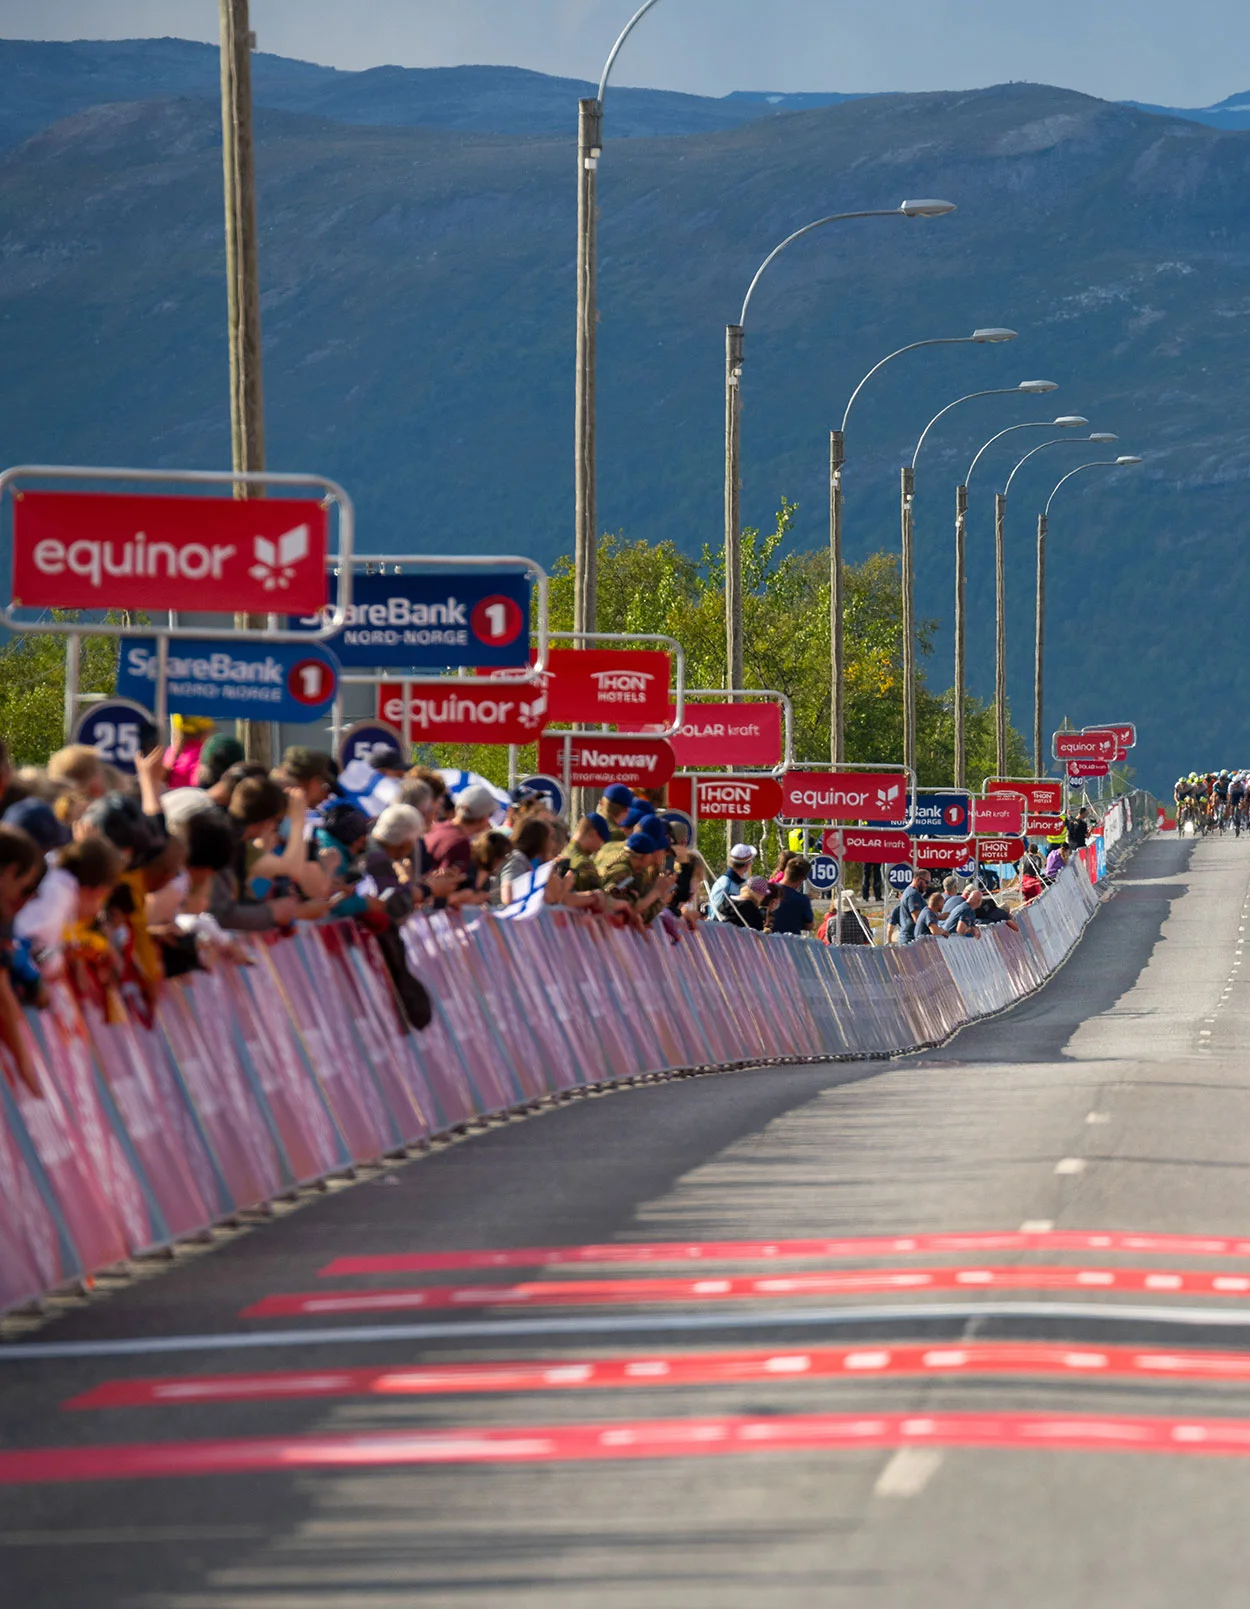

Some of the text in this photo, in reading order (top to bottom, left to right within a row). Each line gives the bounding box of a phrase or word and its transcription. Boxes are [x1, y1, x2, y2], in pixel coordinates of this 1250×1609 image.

[33, 531, 237, 587] equinor
[484, 603, 507, 638] 1
[344, 630, 468, 646] NORD-NORGE
[300, 665, 322, 698] 1
[590, 670, 655, 690] THON
[597, 691, 647, 703] HOTELS
[384, 693, 515, 728] equinor
[728, 723, 760, 736] kraft
[93, 722, 140, 762] 25
[1060, 742, 1097, 753] equinor
[581, 750, 658, 772] Norway
[697, 781, 759, 801] THON
[790, 788, 869, 809] equinor
[700, 802, 751, 815] HOTELS
[949, 808, 958, 823] 1
[846, 838, 905, 849] POLAR kraft
[979, 840, 1012, 851] THON
[909, 846, 954, 859] uinor
[810, 864, 837, 880] 150
[889, 870, 913, 883] 200
